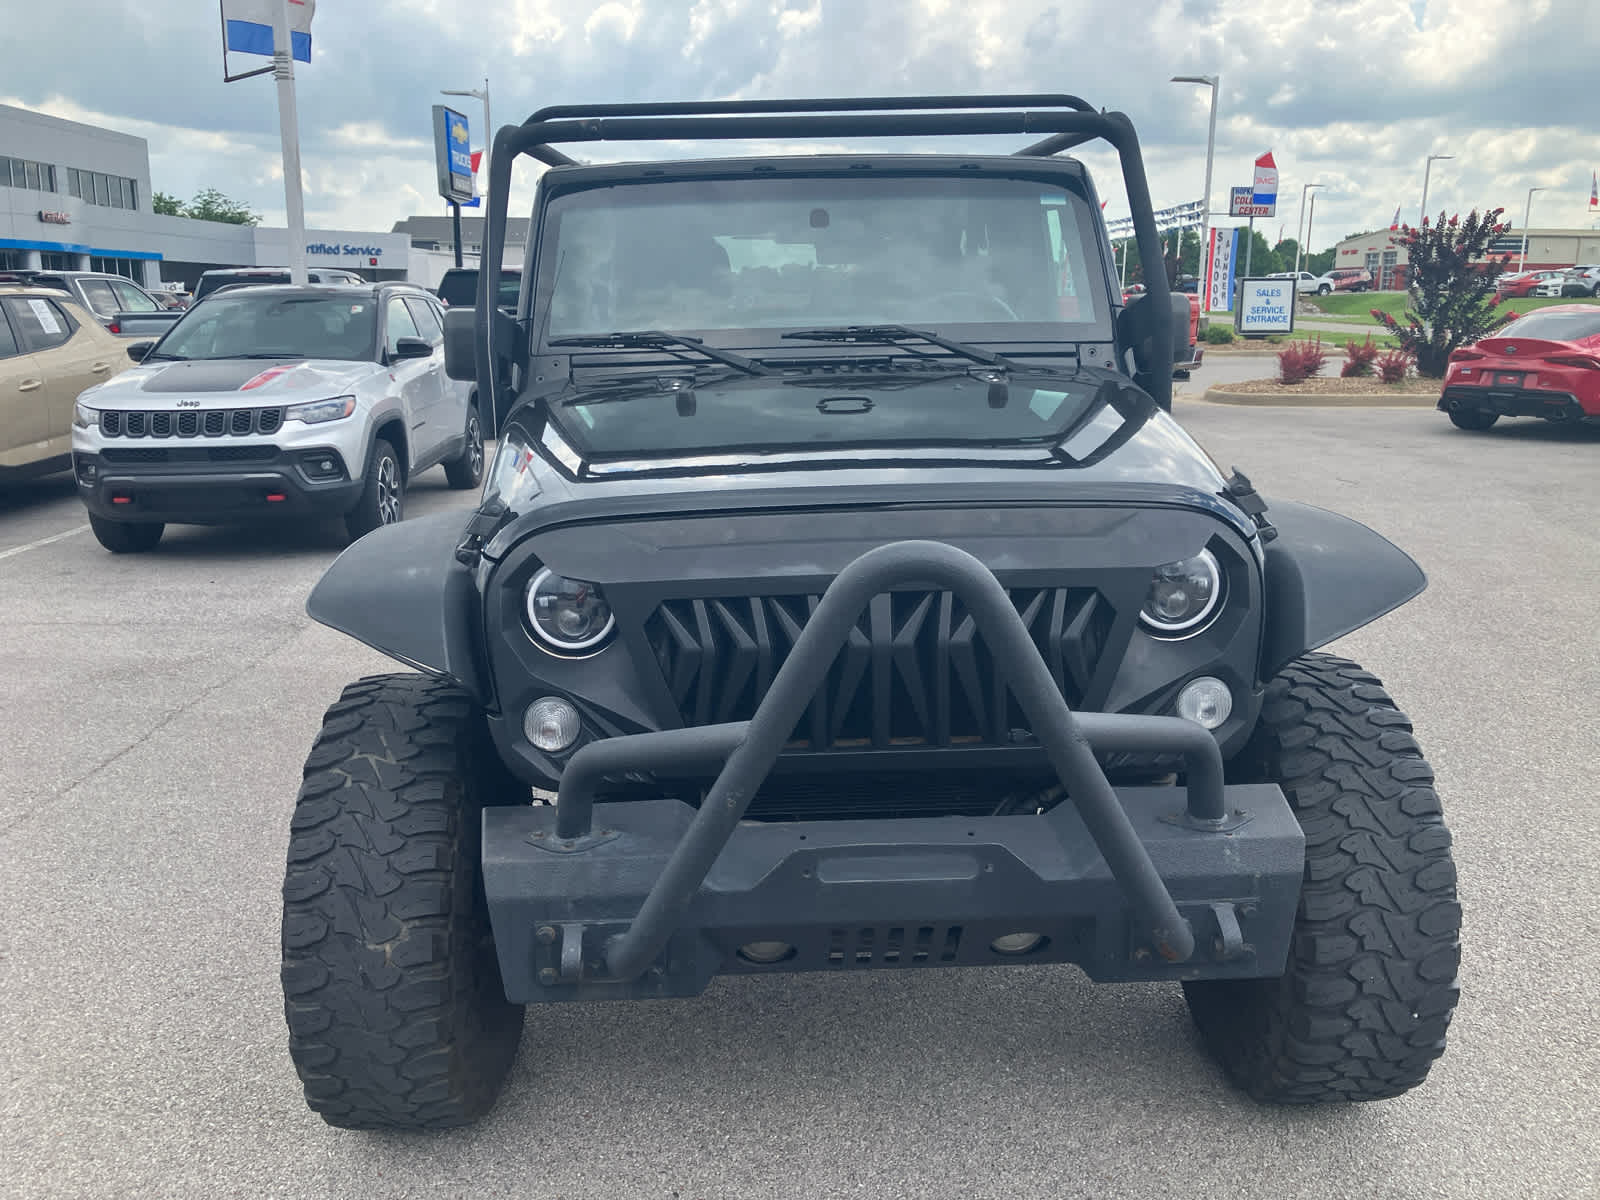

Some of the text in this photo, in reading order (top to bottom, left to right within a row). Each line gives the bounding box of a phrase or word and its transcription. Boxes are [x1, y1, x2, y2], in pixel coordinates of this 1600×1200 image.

[1239, 206, 1269, 216] CENTER
[306, 243, 383, 256] rtified Service
[1256, 288, 1282, 297] SALES
[1250, 306, 1285, 315] SERVICE
[1245, 315, 1289, 324] ENTRANCE
[176, 399, 201, 409] Jeep
